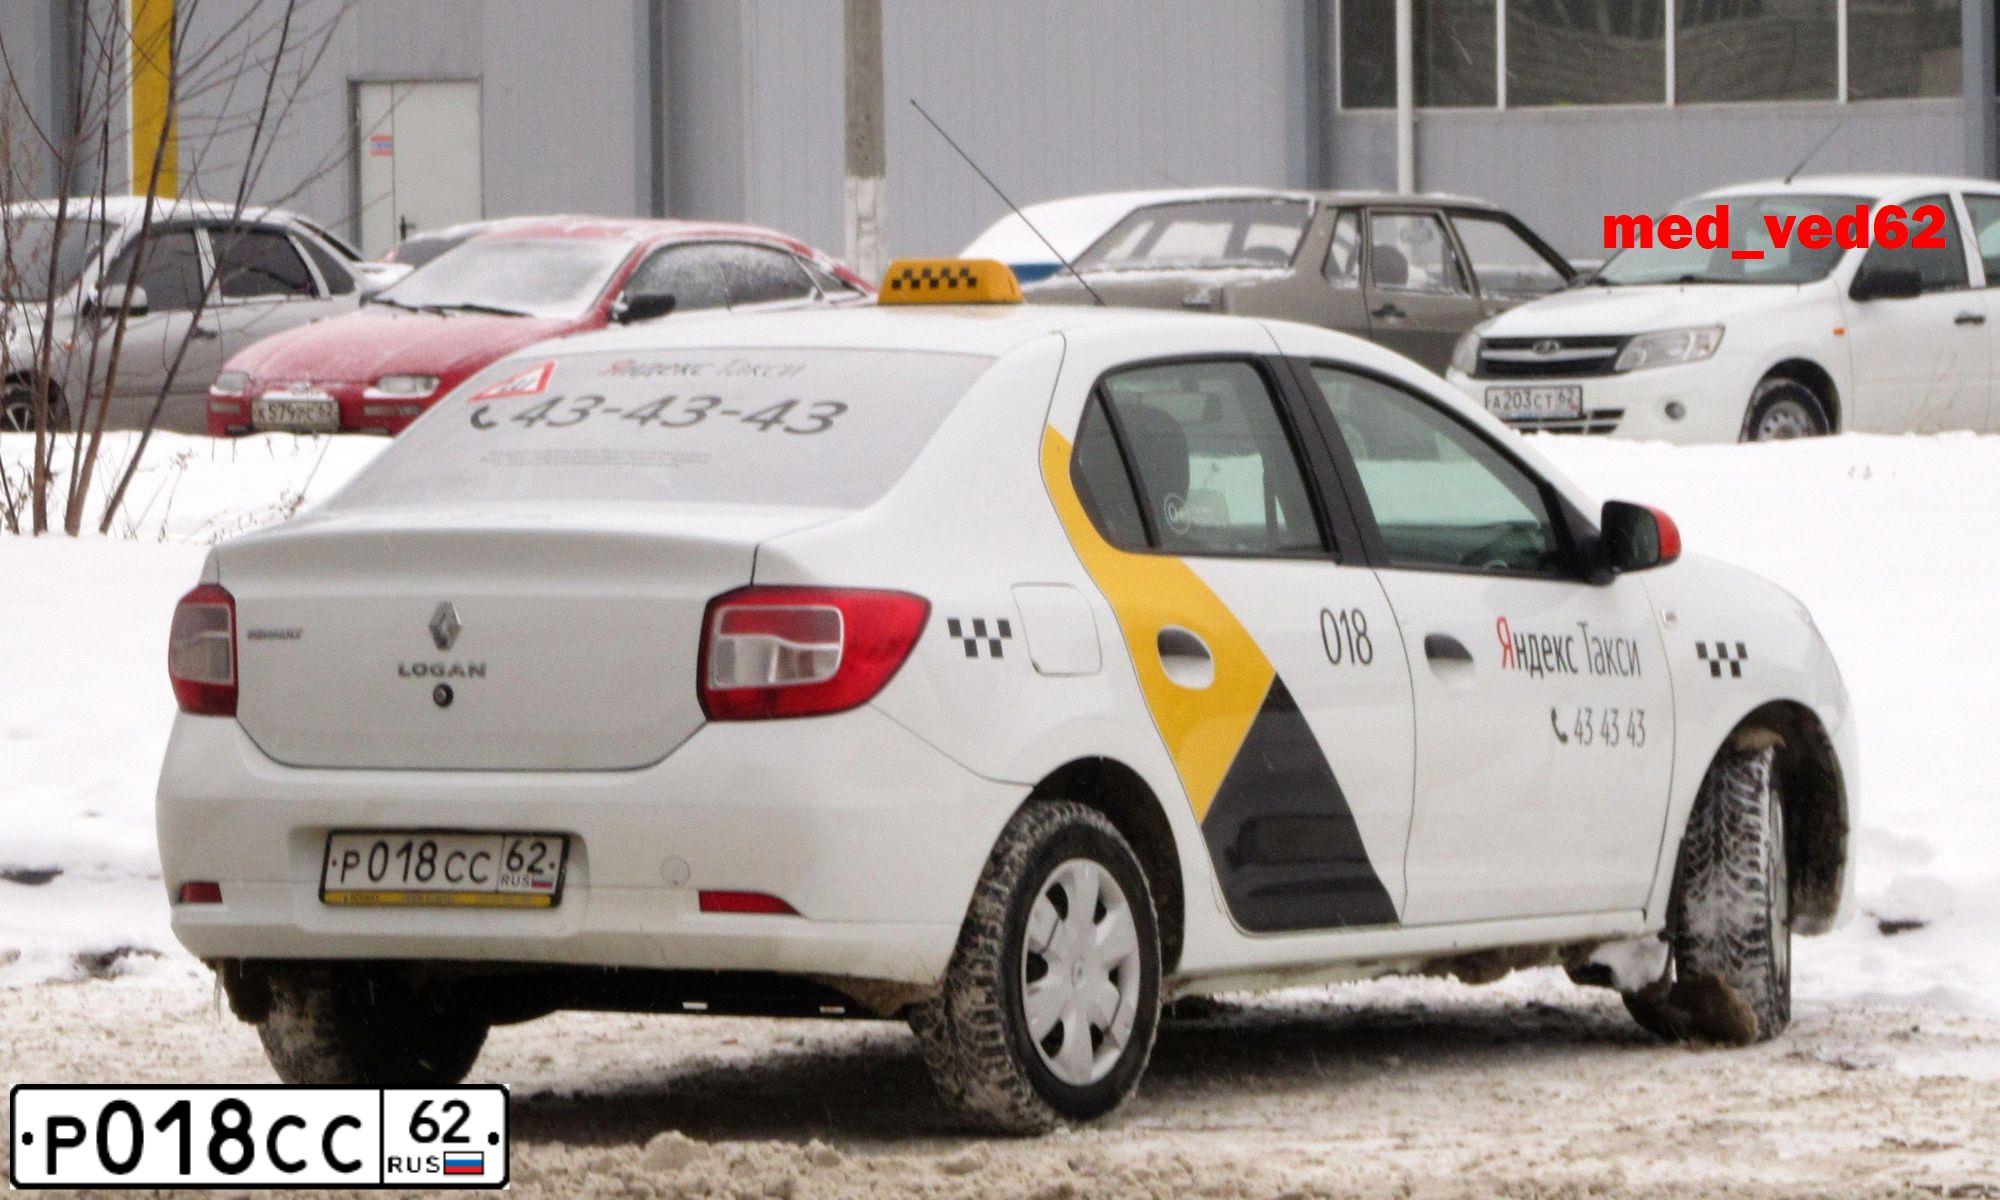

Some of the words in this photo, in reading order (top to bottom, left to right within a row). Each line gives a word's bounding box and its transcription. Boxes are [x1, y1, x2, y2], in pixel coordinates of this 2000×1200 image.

[511, 395, 849, 435] 43-43-43
[1319, 607, 1374, 666] 018
[1496, 615, 1579, 680] Яндекс
[1577, 621, 1642, 678] Такси
[397, 661, 487, 679] LOGAN
[1574, 707, 1594, 747] 43
[1600, 707, 1620, 747] 43
[1626, 708, 1646, 748] 43
[340, 839, 491, 884] Р018СС
[505, 839, 548, 875] 62
[500, 872, 531, 889] RUS
